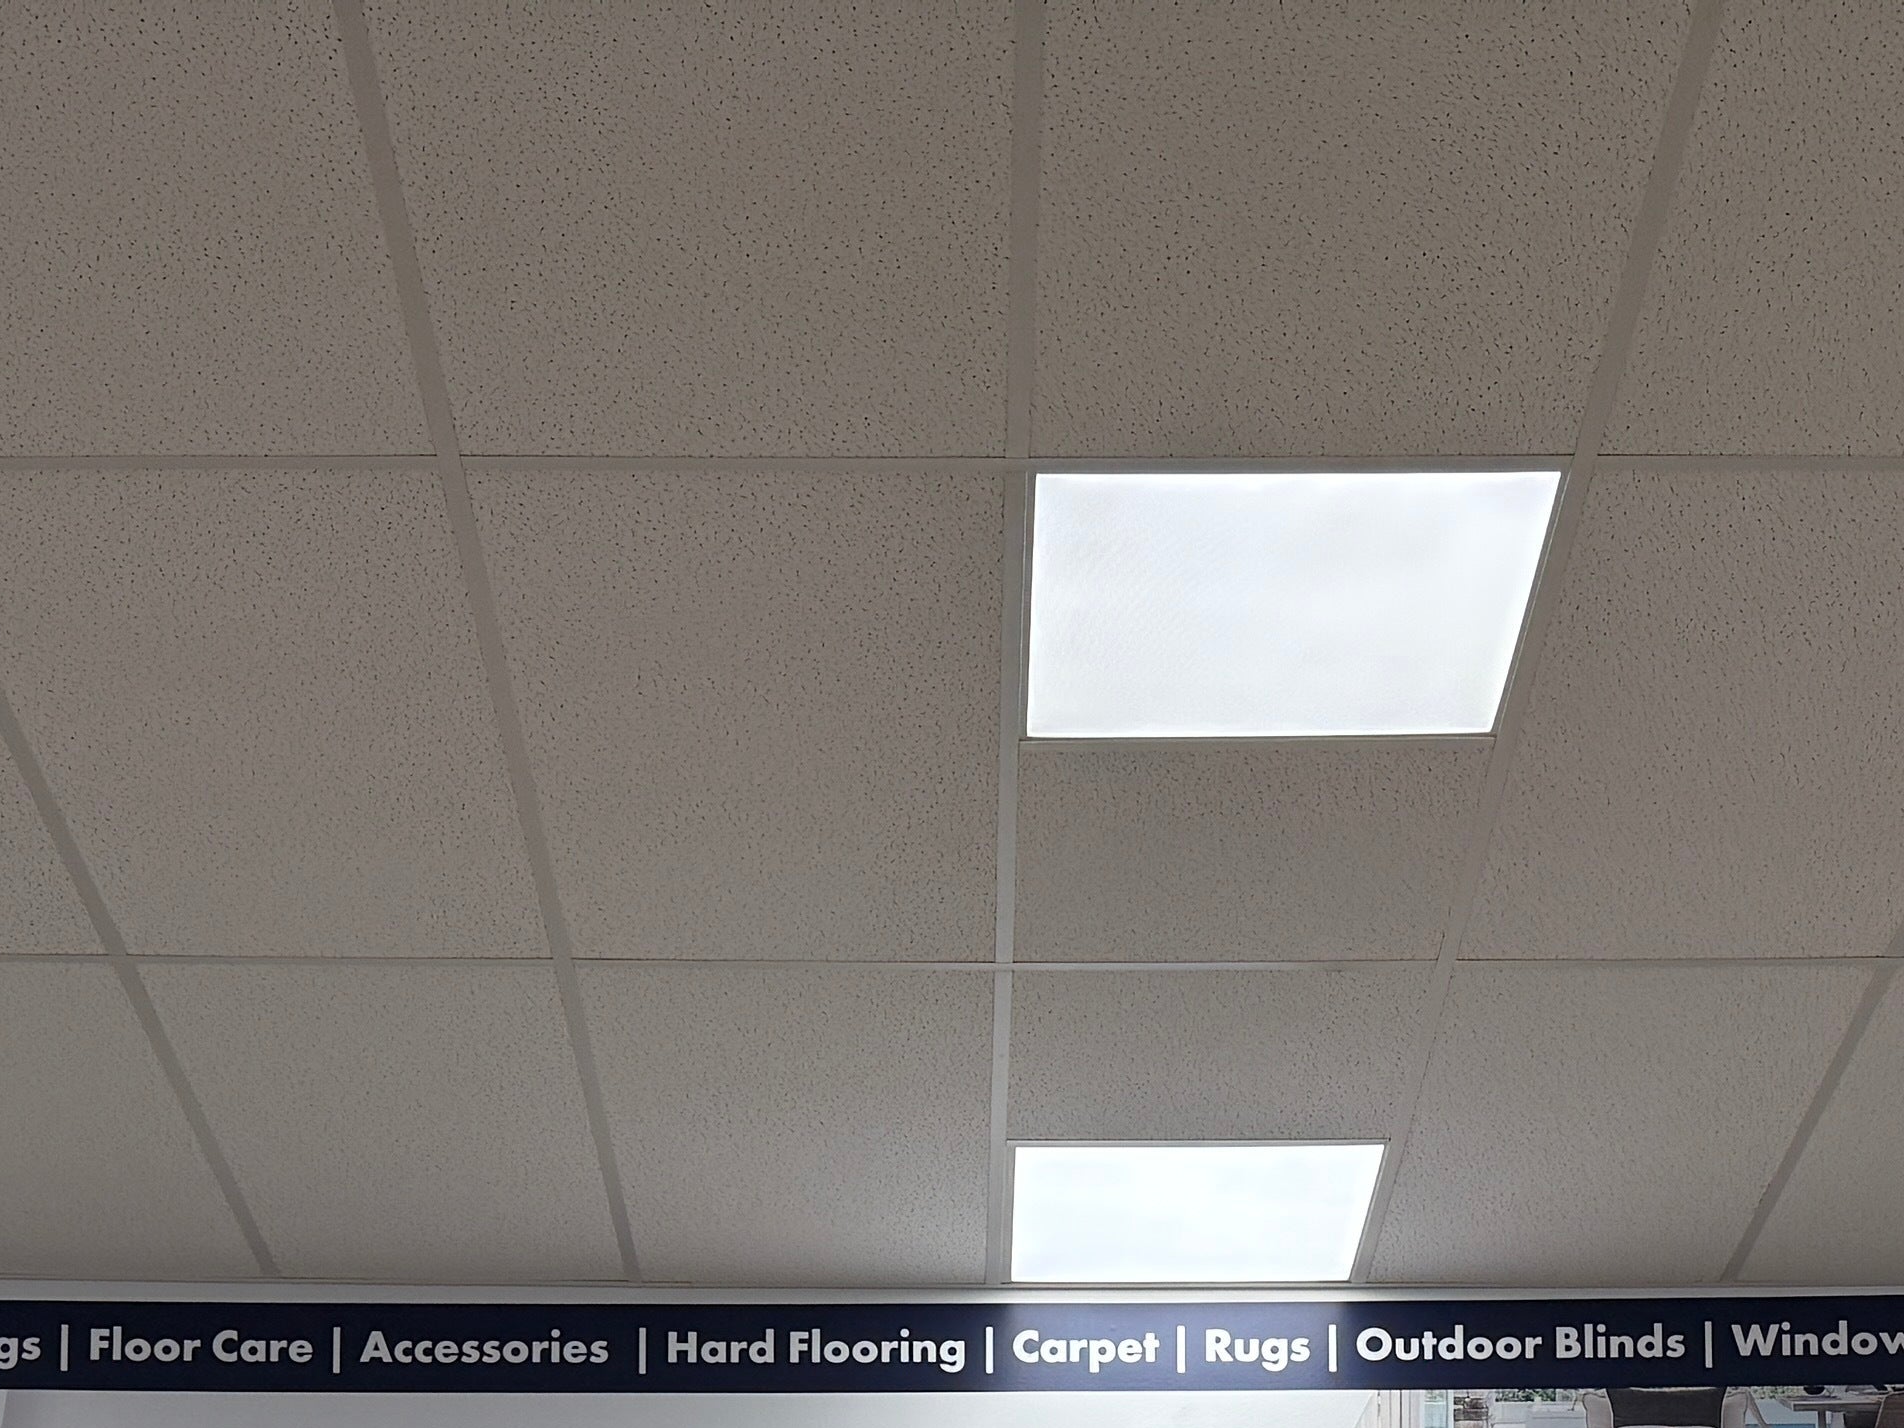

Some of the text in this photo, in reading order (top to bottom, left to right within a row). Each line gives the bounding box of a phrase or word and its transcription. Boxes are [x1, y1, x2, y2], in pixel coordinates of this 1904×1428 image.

[89, 1326, 202, 1362] Floor
[212, 1329, 314, 1364] Care
[359, 1329, 610, 1364] Accessories
[667, 1328, 775, 1364] Hard
[789, 1327, 966, 1373] Flooring
[1012, 1329, 1160, 1374] Carpet
[1205, 1328, 1312, 1371] Rugs
[1356, 1324, 1542, 1362] Outdoor
[1555, 1322, 1686, 1360] Blinds
